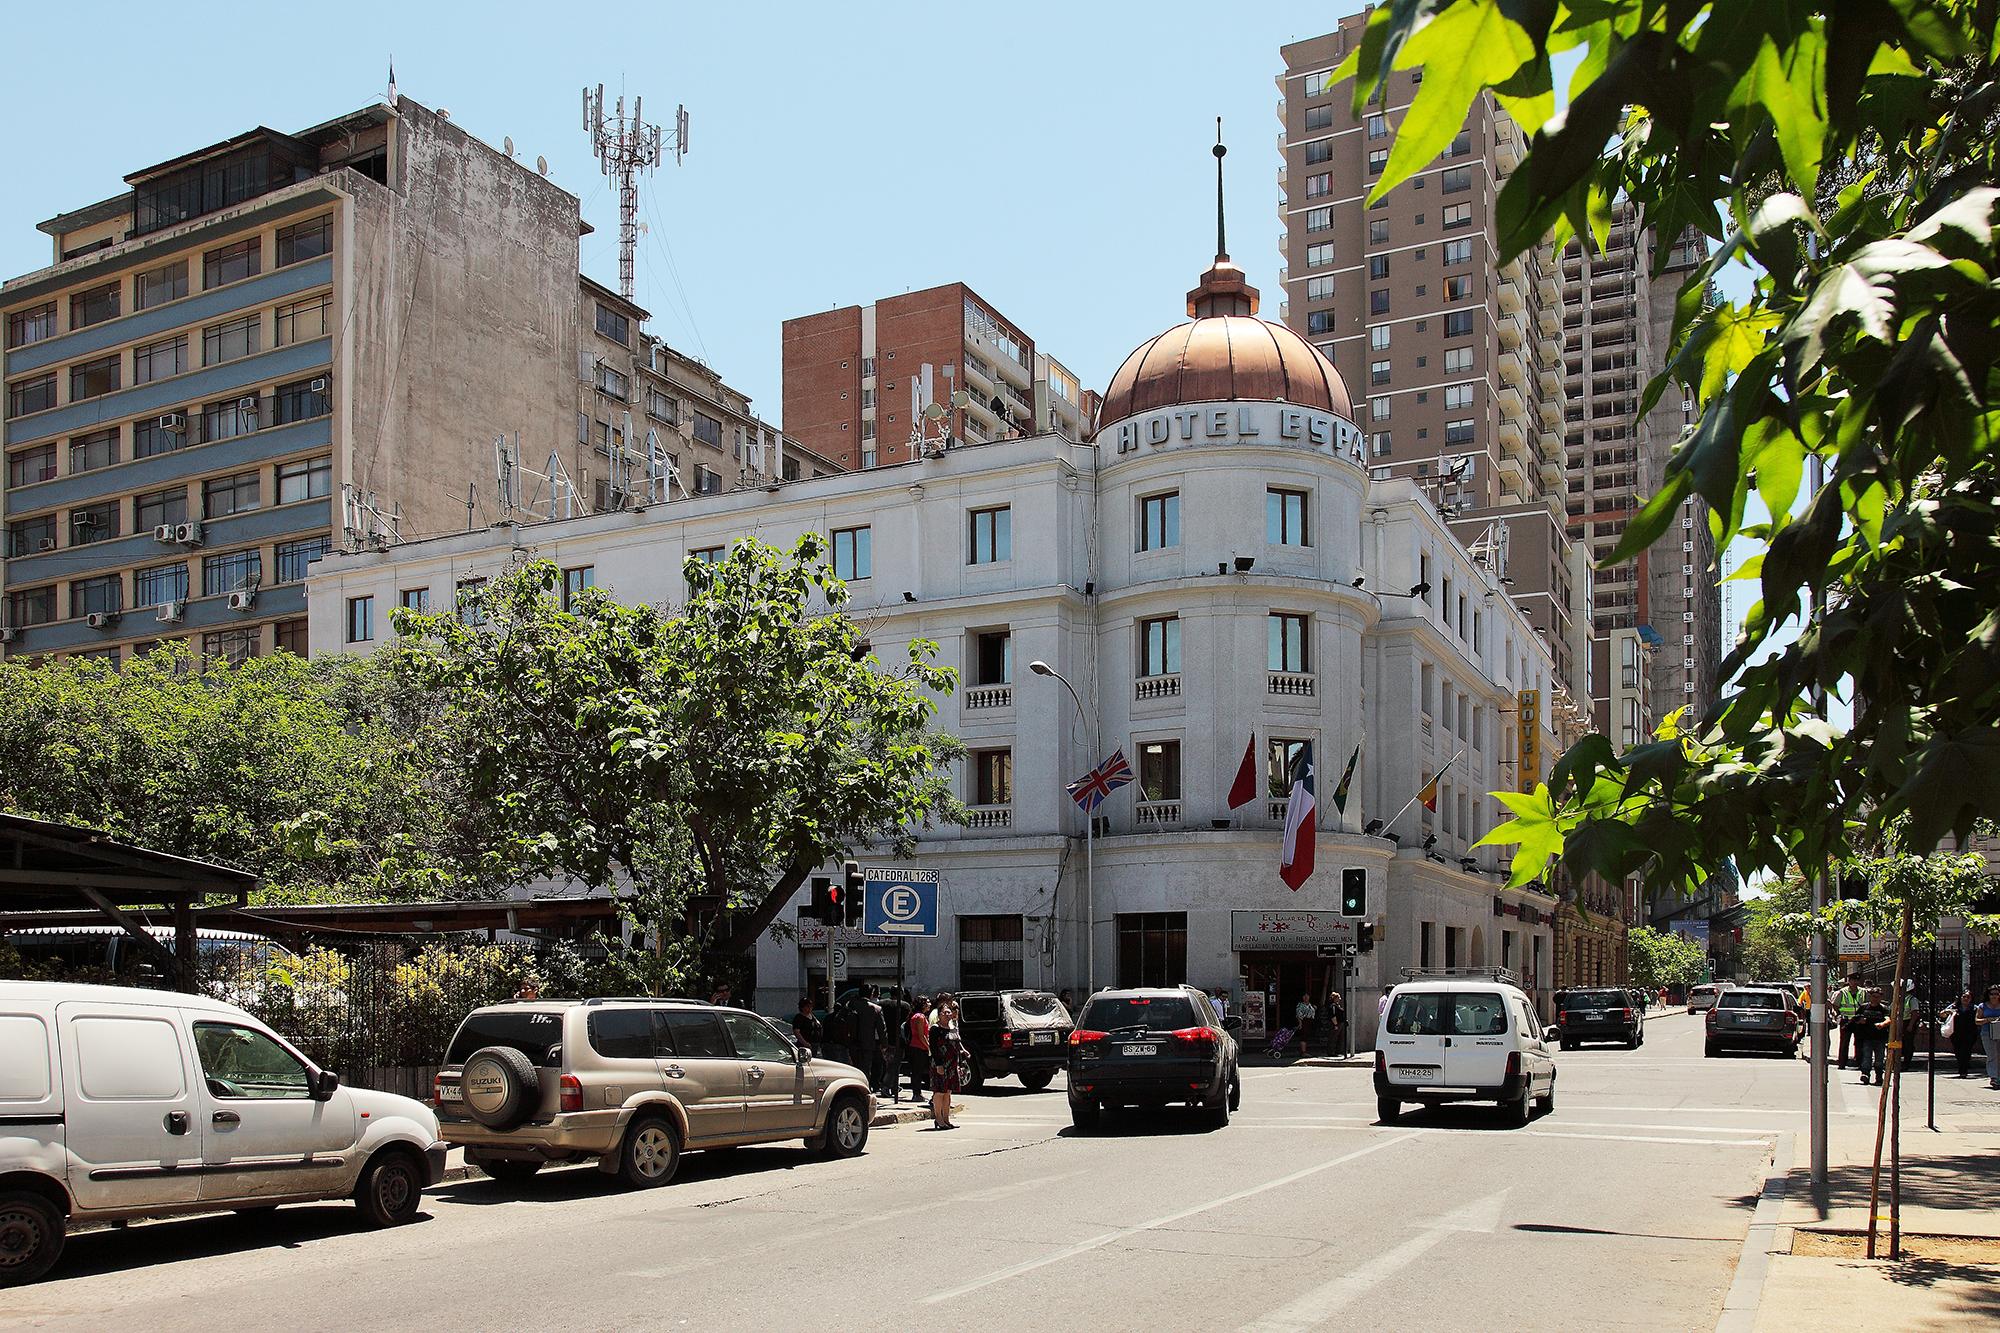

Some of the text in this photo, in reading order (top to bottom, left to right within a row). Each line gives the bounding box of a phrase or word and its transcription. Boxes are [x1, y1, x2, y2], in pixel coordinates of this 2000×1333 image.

[1117, 407, 1259, 454] HOTEL
[1521, 692, 1534, 771] HOTEL
[868, 869, 938, 883] CATEDRAL 1268
[892, 891, 909, 914] E
